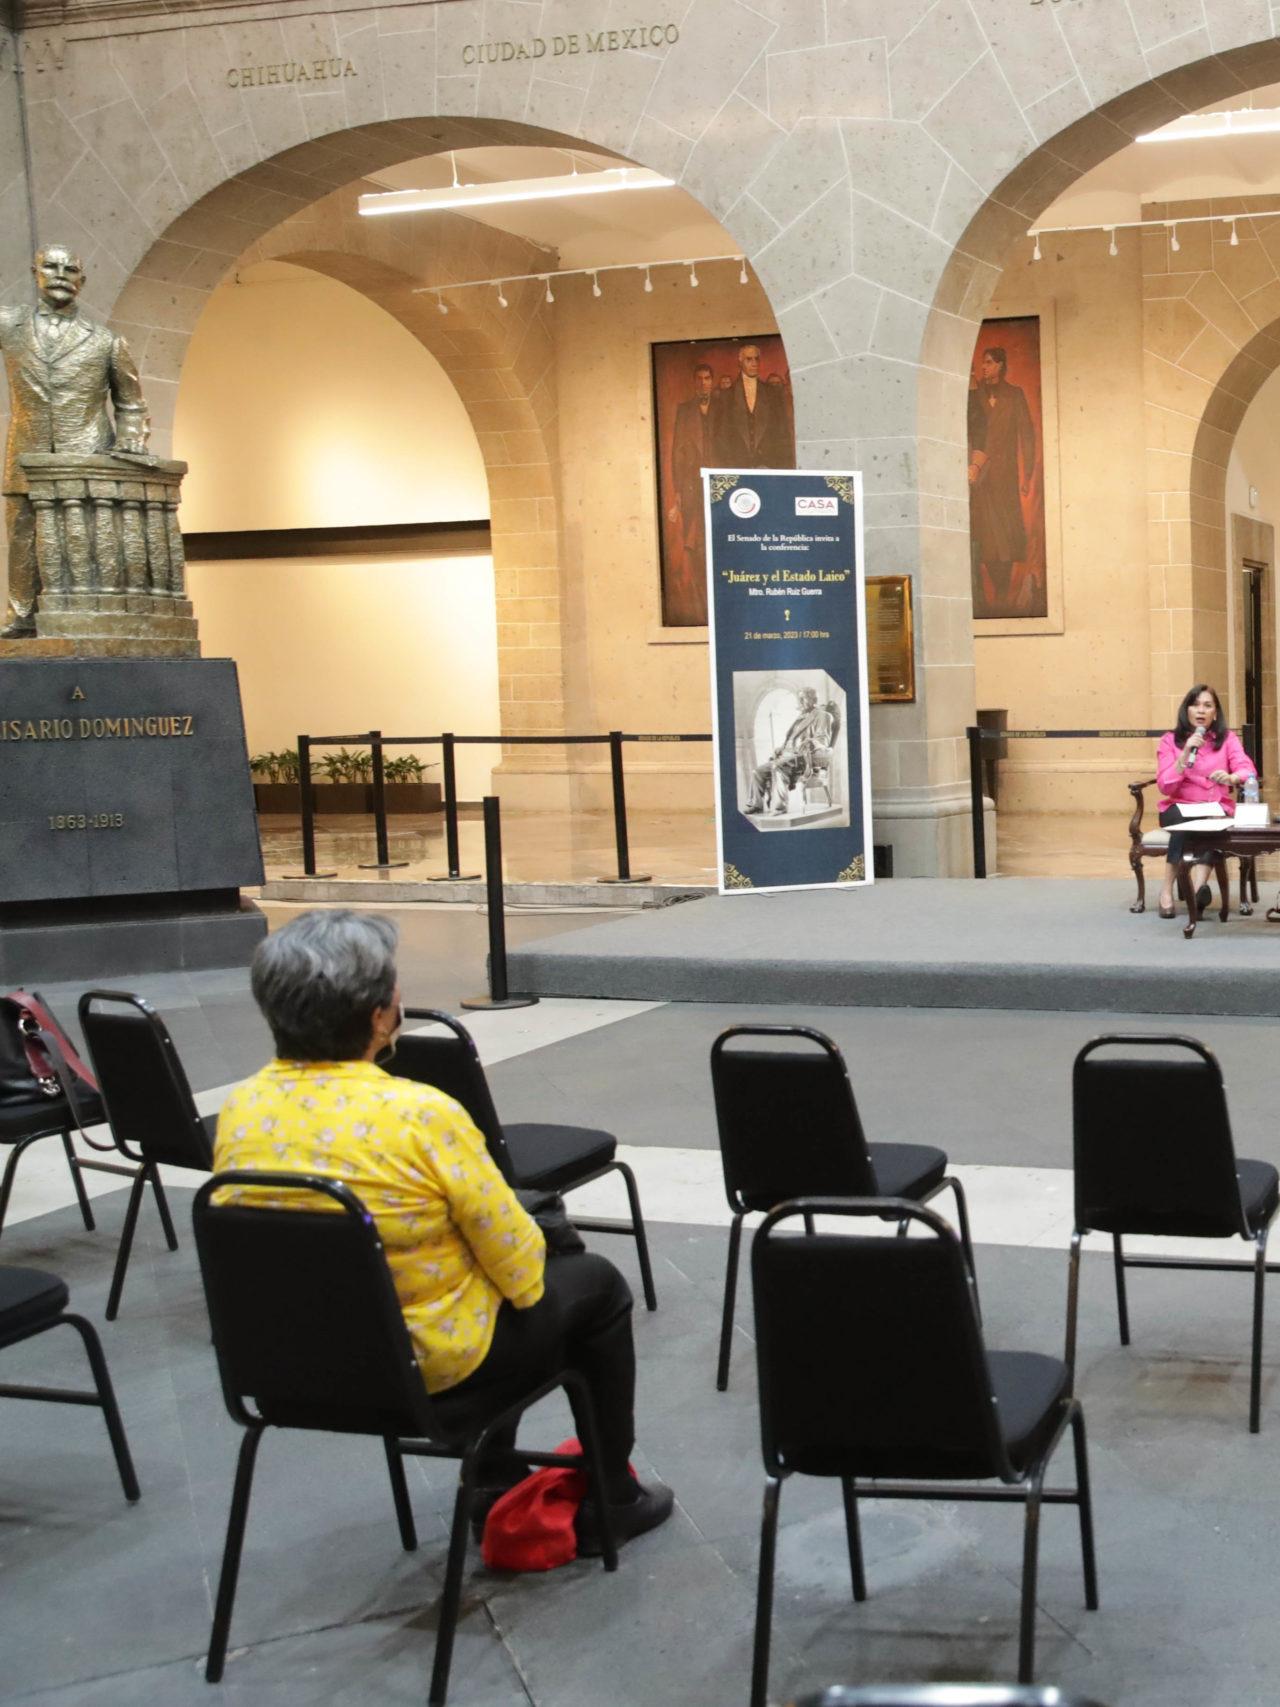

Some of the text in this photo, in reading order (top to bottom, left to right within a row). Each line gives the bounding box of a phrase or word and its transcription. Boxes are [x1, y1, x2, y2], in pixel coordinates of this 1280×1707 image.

[462, 24, 679, 64] CIUDAD DE MEXICO
[227, 57, 358, 88] CHIHUAHUA
[798, 499, 834, 509] CASA
[727, 534, 735, 542] El
[736, 534, 761, 542] Senado
[762, 534, 771, 542] de
[772, 534, 779, 542] la
[780, 534, 813, 543] República
[815, 534, 833, 542] invita
[761, 543, 810, 551] la conferencia:
[762, 573, 769, 586] y
[771, 570, 780, 582] el
[783, 569, 816, 582] Estado
[748, 587, 823, 596] Mtro. Rubén Ruiz Guerra
[744, 631, 752, 640] 21
[753, 631, 761, 640] de
[762, 632, 783, 640] marzo,
[71, 686, 85, 700] A
[0, 715, 194, 741] ISARIO DOMINGUEZ
[49, 813, 124, 829] 1863-1913
